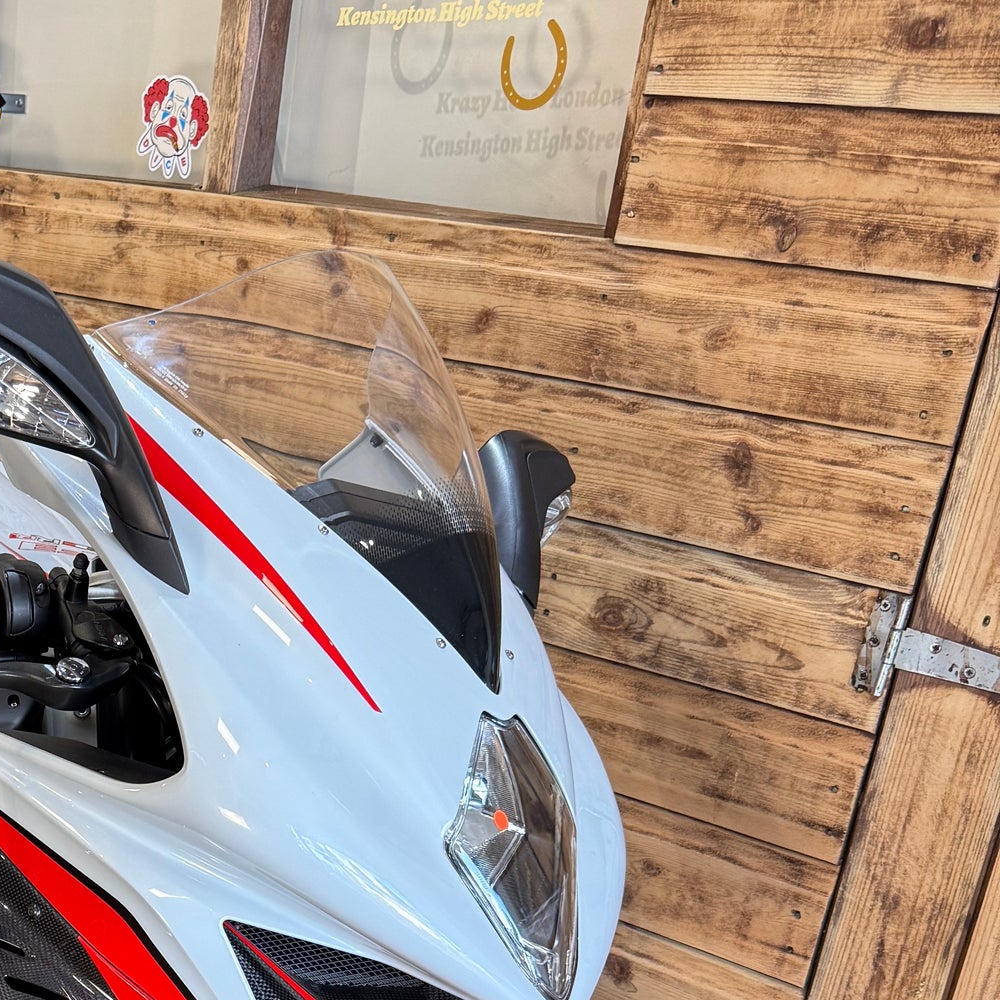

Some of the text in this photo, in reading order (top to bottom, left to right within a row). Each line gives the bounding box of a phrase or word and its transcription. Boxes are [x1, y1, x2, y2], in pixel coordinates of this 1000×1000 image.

[336, 0, 544, 31] Kensington High Street
[420, 131, 523, 162] Kensington
[525, 125, 573, 158] High
